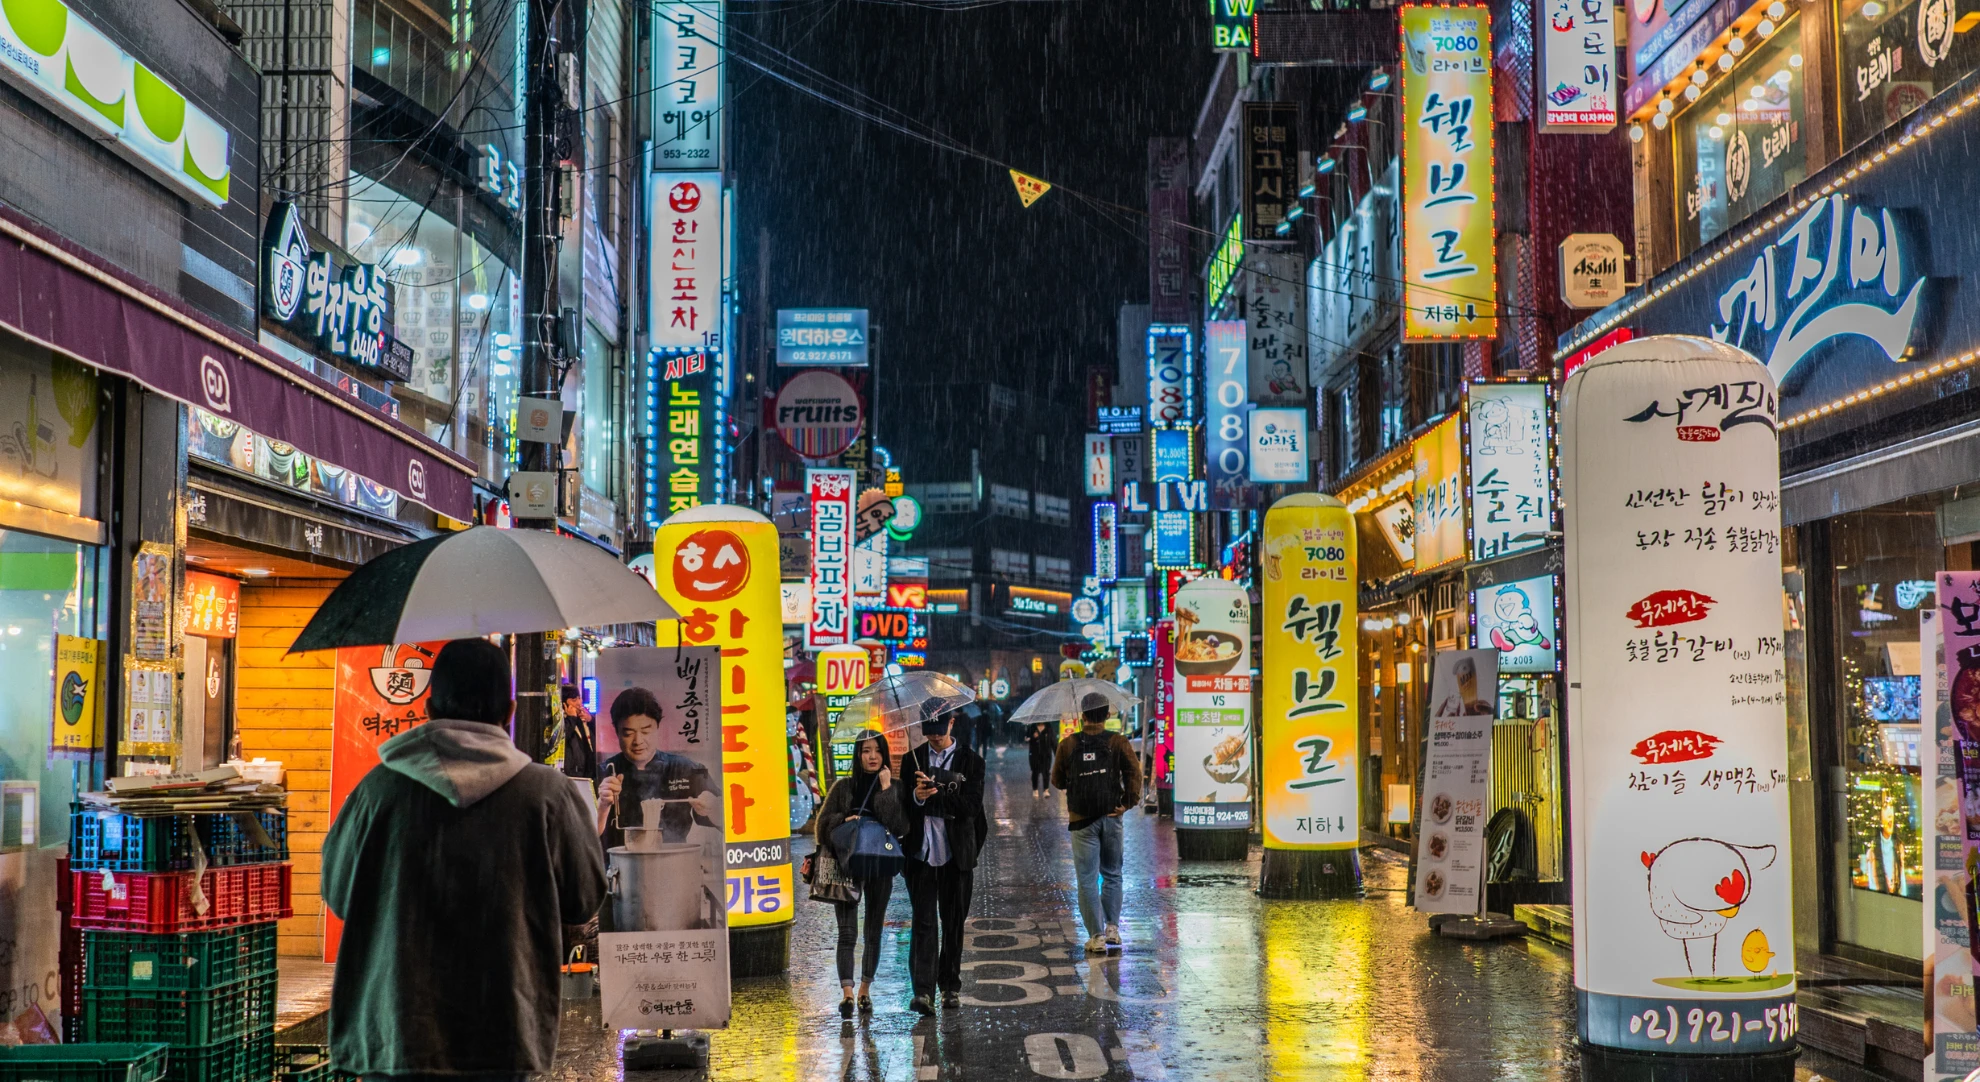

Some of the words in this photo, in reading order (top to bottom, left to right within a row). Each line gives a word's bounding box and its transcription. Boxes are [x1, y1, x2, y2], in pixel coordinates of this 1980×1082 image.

[1214, 25, 1250, 47] BA
[1432, 35, 1478, 51] 7080
[677, 13, 697, 104] 로코코
[1432, 57, 1487, 73] 라이브
[663, 110, 711, 141] 헤어
[663, 148, 710, 159] 953-2322
[1420, 93, 1476, 278] 쉘브르
[671, 219, 699, 331] 한신포차
[1573, 257, 1617, 276] Asahi
[1589, 278, 1602, 288] 生
[1710, 192, 1927, 389] 계진미
[307, 252, 388, 354] 역전우동
[1424, 305, 1460, 323] 지하
[351, 330, 378, 367] 0410
[701, 331, 719, 346] 1F
[780, 328, 865, 346] 원더하우스
[664, 353, 706, 381] 시티
[793, 351, 852, 361] 02.927.6171
[206, 367, 223, 399] CU
[1158, 346, 1183, 422] 7080
[1217, 347, 1244, 475] 7080
[1258, 434, 1299, 452] 이차돌
[1091, 441, 1105, 487] BAR
[411, 469, 424, 485] CU
[886, 472, 900, 482] 24
[1625, 487, 1690, 508] 신선한
[1752, 489, 1778, 513] 맛있
[1636, 529, 1675, 550] 농장
[1684, 527, 1718, 551] 직송
[1725, 526, 1779, 554] 숯불닭갈
[1304, 546, 1345, 561] 7080
[1301, 567, 1348, 581] 라이브
[888, 586, 926, 607] VR
[1228, 608, 1249, 625] 이차
[1640, 595, 1703, 627] 무제한
[861, 613, 909, 638] DVD
[1513, 656, 1533, 666] 2003
[826, 659, 866, 690] DVD
[676, 656, 703, 744] 백종원
[1212, 695, 1226, 707] VS
[1284, 596, 1346, 790] 쉘브르
[1645, 734, 1706, 764] 무제한
[1629, 771, 1686, 795] 참이슬
[1700, 767, 1757, 795] 생맥주
[1296, 816, 1332, 835] 지하
[726, 875, 781, 915] 가능
[614, 952, 648, 965] 가득한
[651, 951, 673, 964] 우동
[676, 950, 689, 962] 한
[691, 948, 716, 963] 그릇!
[44, 970, 61, 1001] C
[653, 998, 694, 1016] 역전우동
